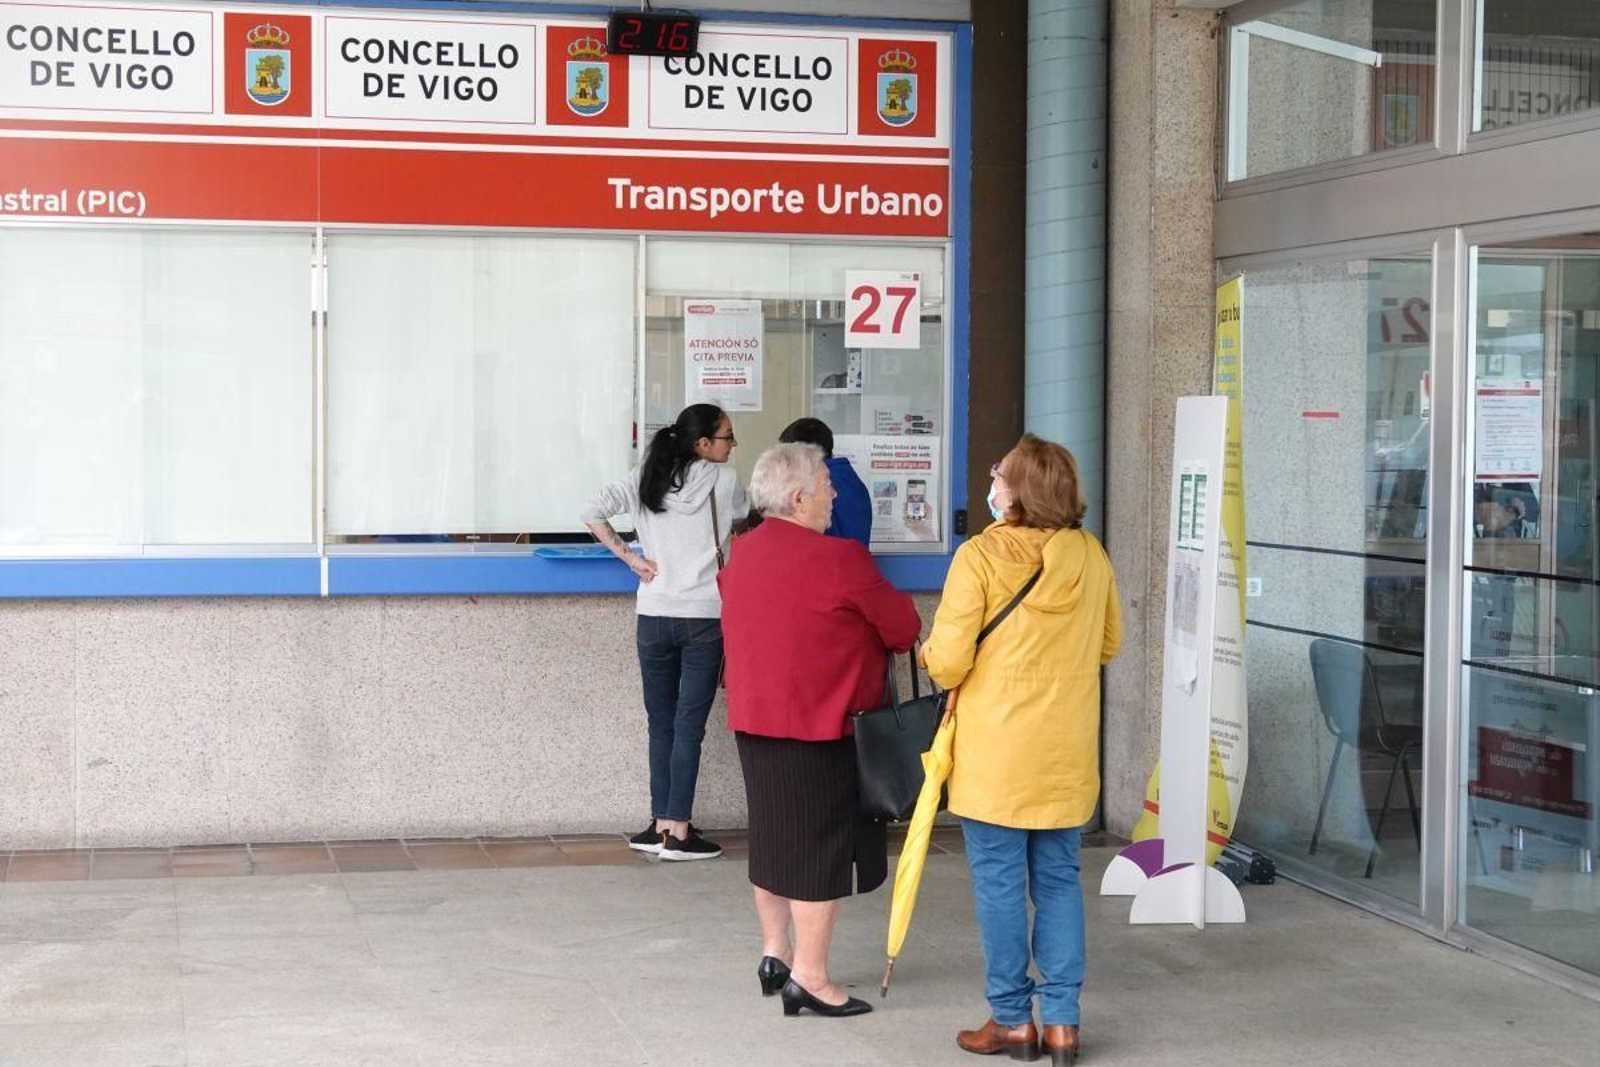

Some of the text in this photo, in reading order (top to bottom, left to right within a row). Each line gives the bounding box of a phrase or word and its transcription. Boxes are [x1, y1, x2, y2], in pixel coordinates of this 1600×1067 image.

[6, 25, 195, 56] CONCELLO
[340, 38, 519, 68] CONCELLO
[30, 61, 173, 91] DE VIGO
[664, 52, 833, 81] CONCELLO
[363, 73, 498, 102] DE VIGO
[685, 85, 813, 113] DE VIGO
[0, 187, 147, 216] stral (PIC)
[607, 178, 943, 218] Transporte Urbano
[850, 285, 916, 334] 27
[689, 335, 758, 349] ATENCIÓN SÓ
[693, 352, 754, 362] CITA PREVIA
